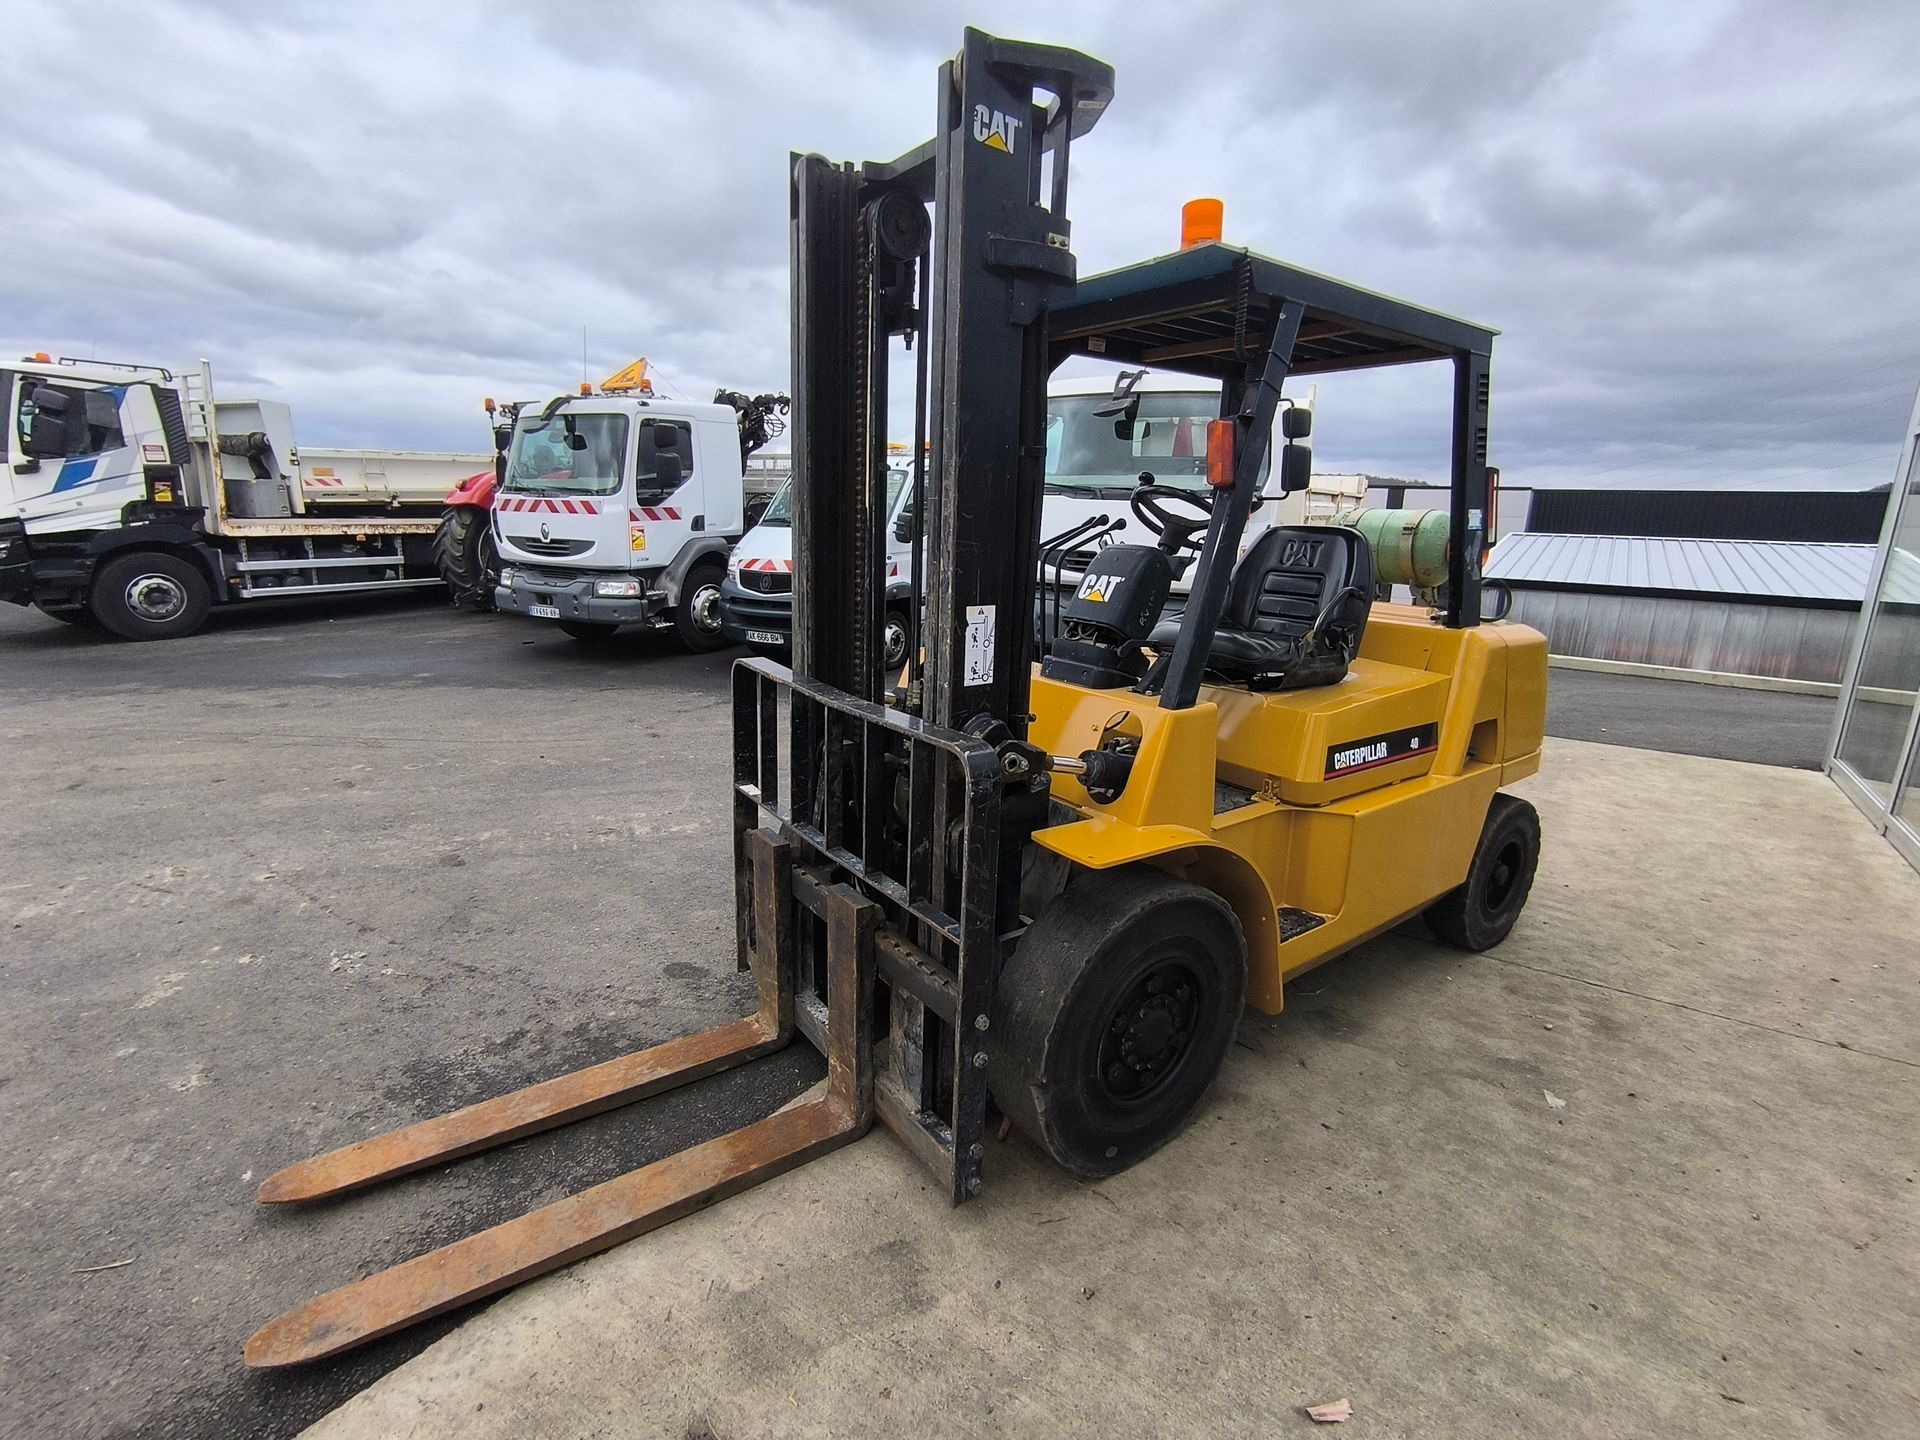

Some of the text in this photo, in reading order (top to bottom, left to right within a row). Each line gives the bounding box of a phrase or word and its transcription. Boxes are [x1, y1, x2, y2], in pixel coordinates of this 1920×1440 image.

[973, 104, 1019, 155] CAT
[1280, 539, 1325, 568] CAT
[1078, 573, 1122, 603] CAT
[1334, 737, 1419, 770] CATERPILLAR 40
